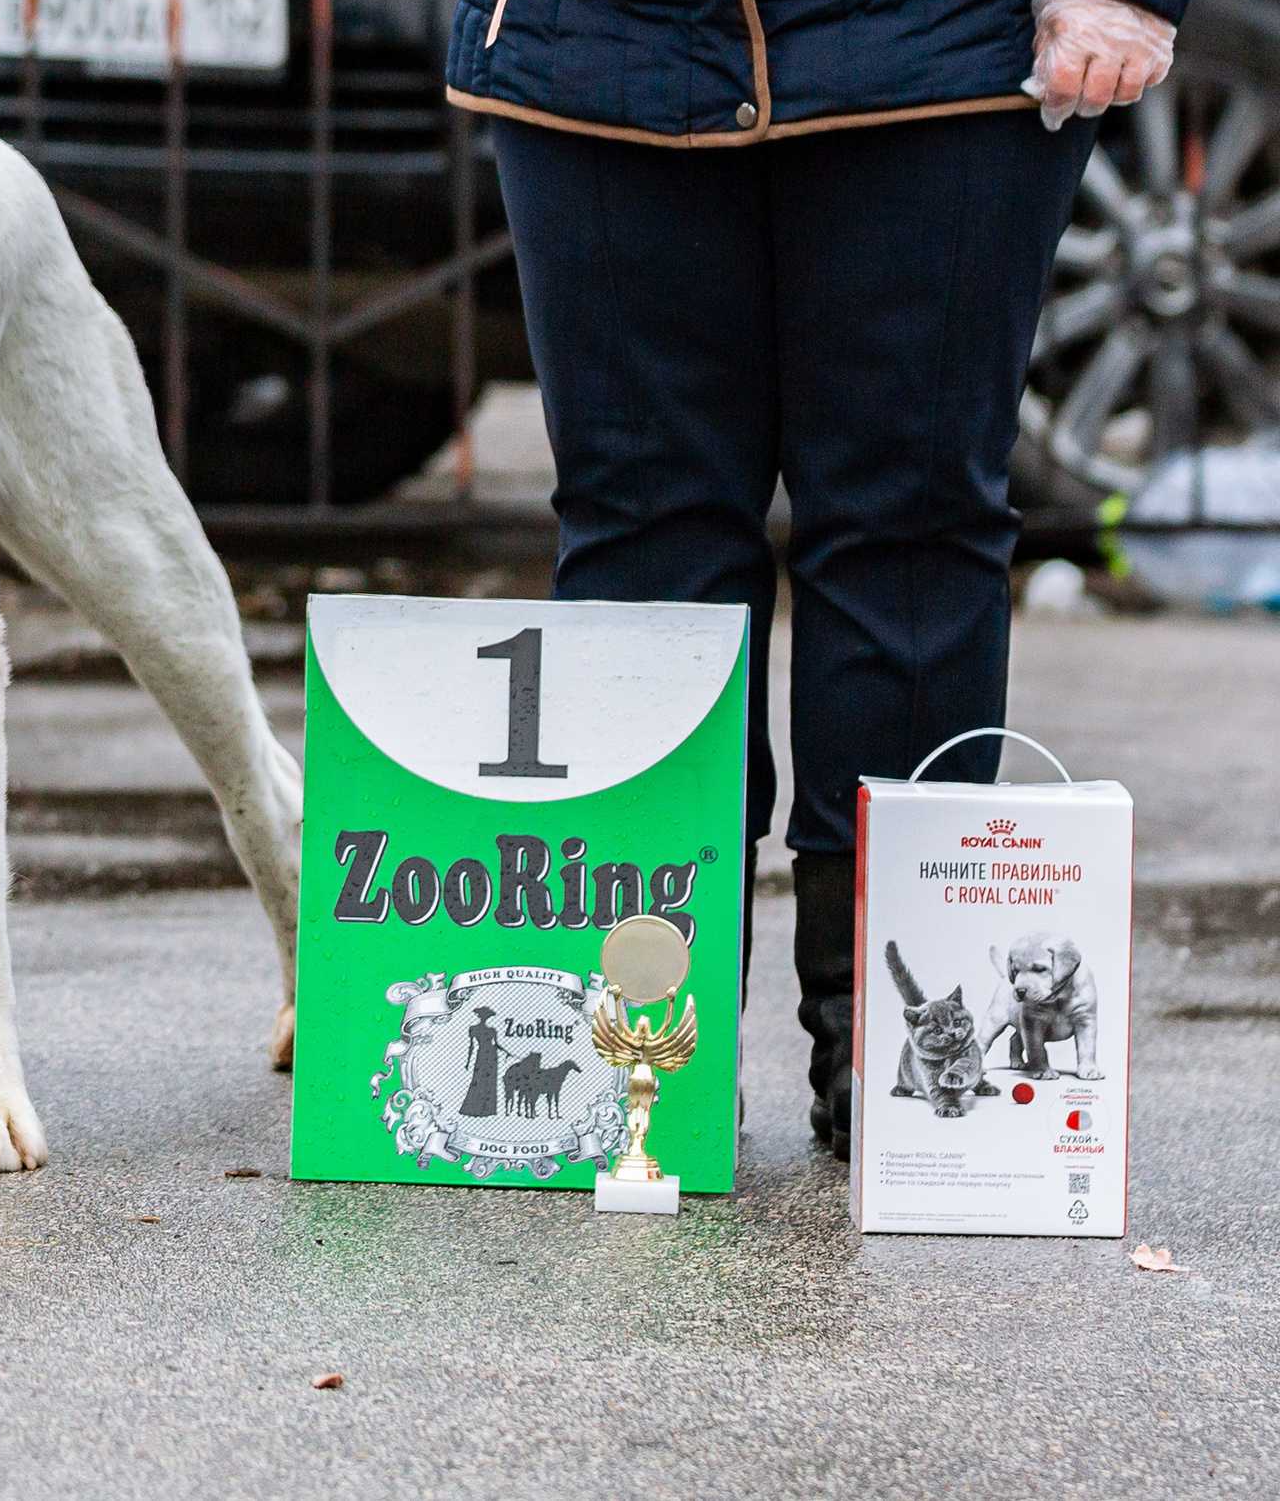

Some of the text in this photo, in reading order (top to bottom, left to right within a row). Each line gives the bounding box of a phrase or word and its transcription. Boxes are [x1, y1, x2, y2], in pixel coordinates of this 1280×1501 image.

[477, 627, 568, 779] 1
[960, 836, 1042, 849] ROYAL CANIN
[920, 861, 1082, 882] НАЧНИТЕ ПРАВИЛЬНО
[944, 886, 954, 903] С
[959, 886, 1003, 904] ROYAL
[468, 970, 565, 982] HIGH QUALITY
[1059, 1134, 1092, 1143] СУХОЙ
[479, 1143, 550, 1154] DOG FOOD
[1054, 1144, 1105, 1153] ВЛАЖНЫЙ
[885, 1151, 913, 1159] Продукт
[885, 1160, 937, 1169] Ветеринарный
[885, 1169, 929, 1177] Руководство
[885, 1178, 906, 1186] Купон
[957, 1181, 982, 1189] первую
[984, 1181, 1012, 1189] покупку
